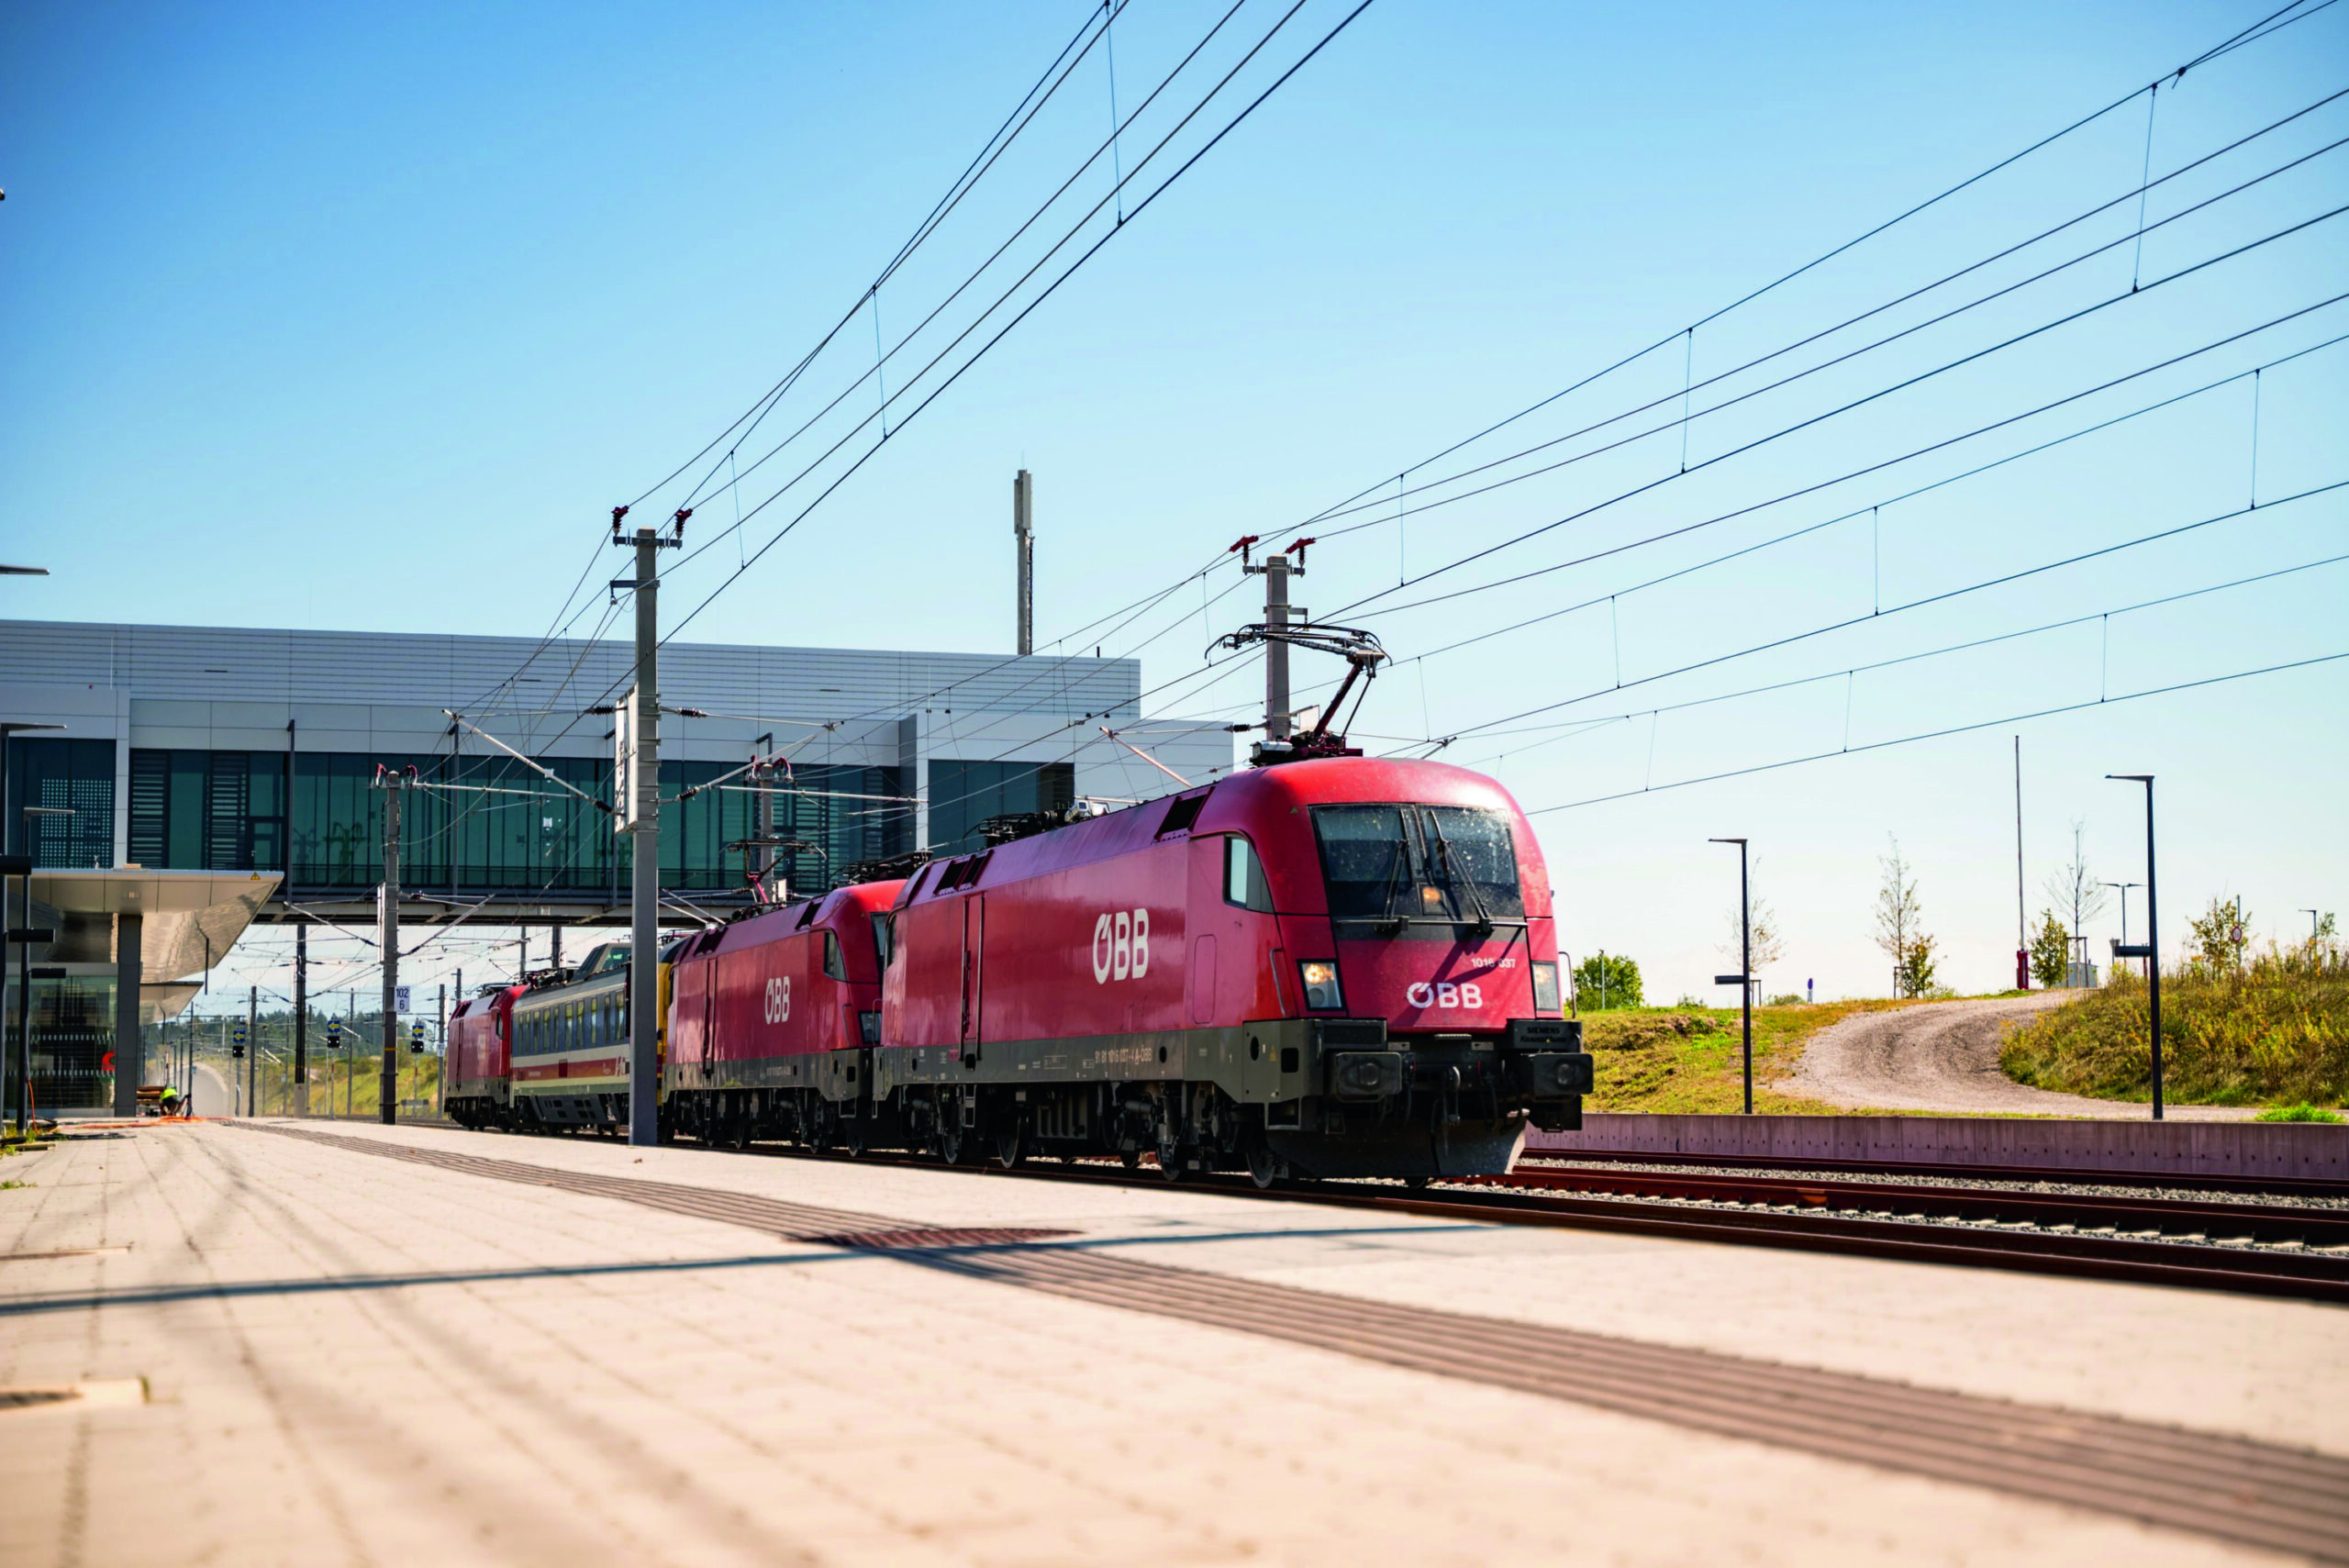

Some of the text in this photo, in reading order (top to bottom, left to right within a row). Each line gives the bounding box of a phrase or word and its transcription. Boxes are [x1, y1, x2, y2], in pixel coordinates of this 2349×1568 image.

[1471, 957, 1516, 968] 1016 037
[395, 987, 409, 998] 102
[399, 999, 405, 1010] 6
